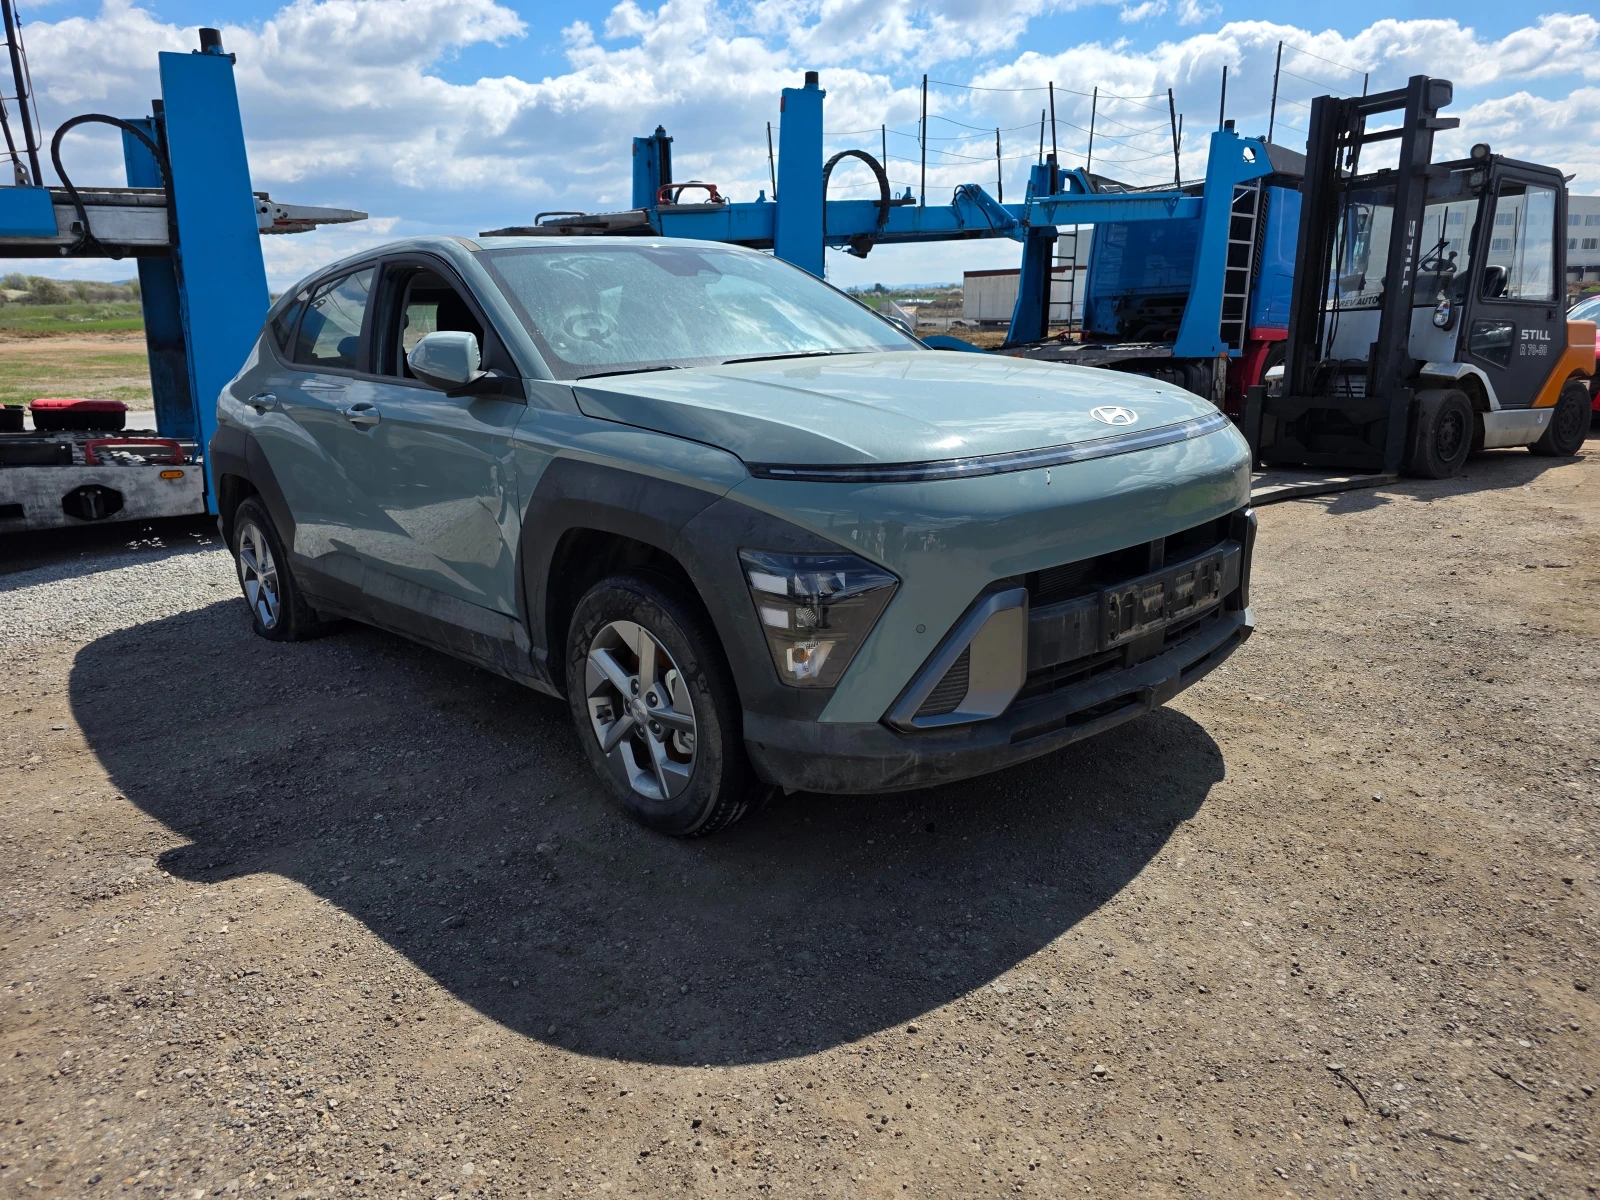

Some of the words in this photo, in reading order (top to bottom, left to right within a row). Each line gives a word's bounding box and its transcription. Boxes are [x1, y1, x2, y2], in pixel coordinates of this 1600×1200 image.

[1402, 220, 1416, 293] STILL
[1521, 329, 1551, 341] STILL
[1520, 344, 1526, 355] R
